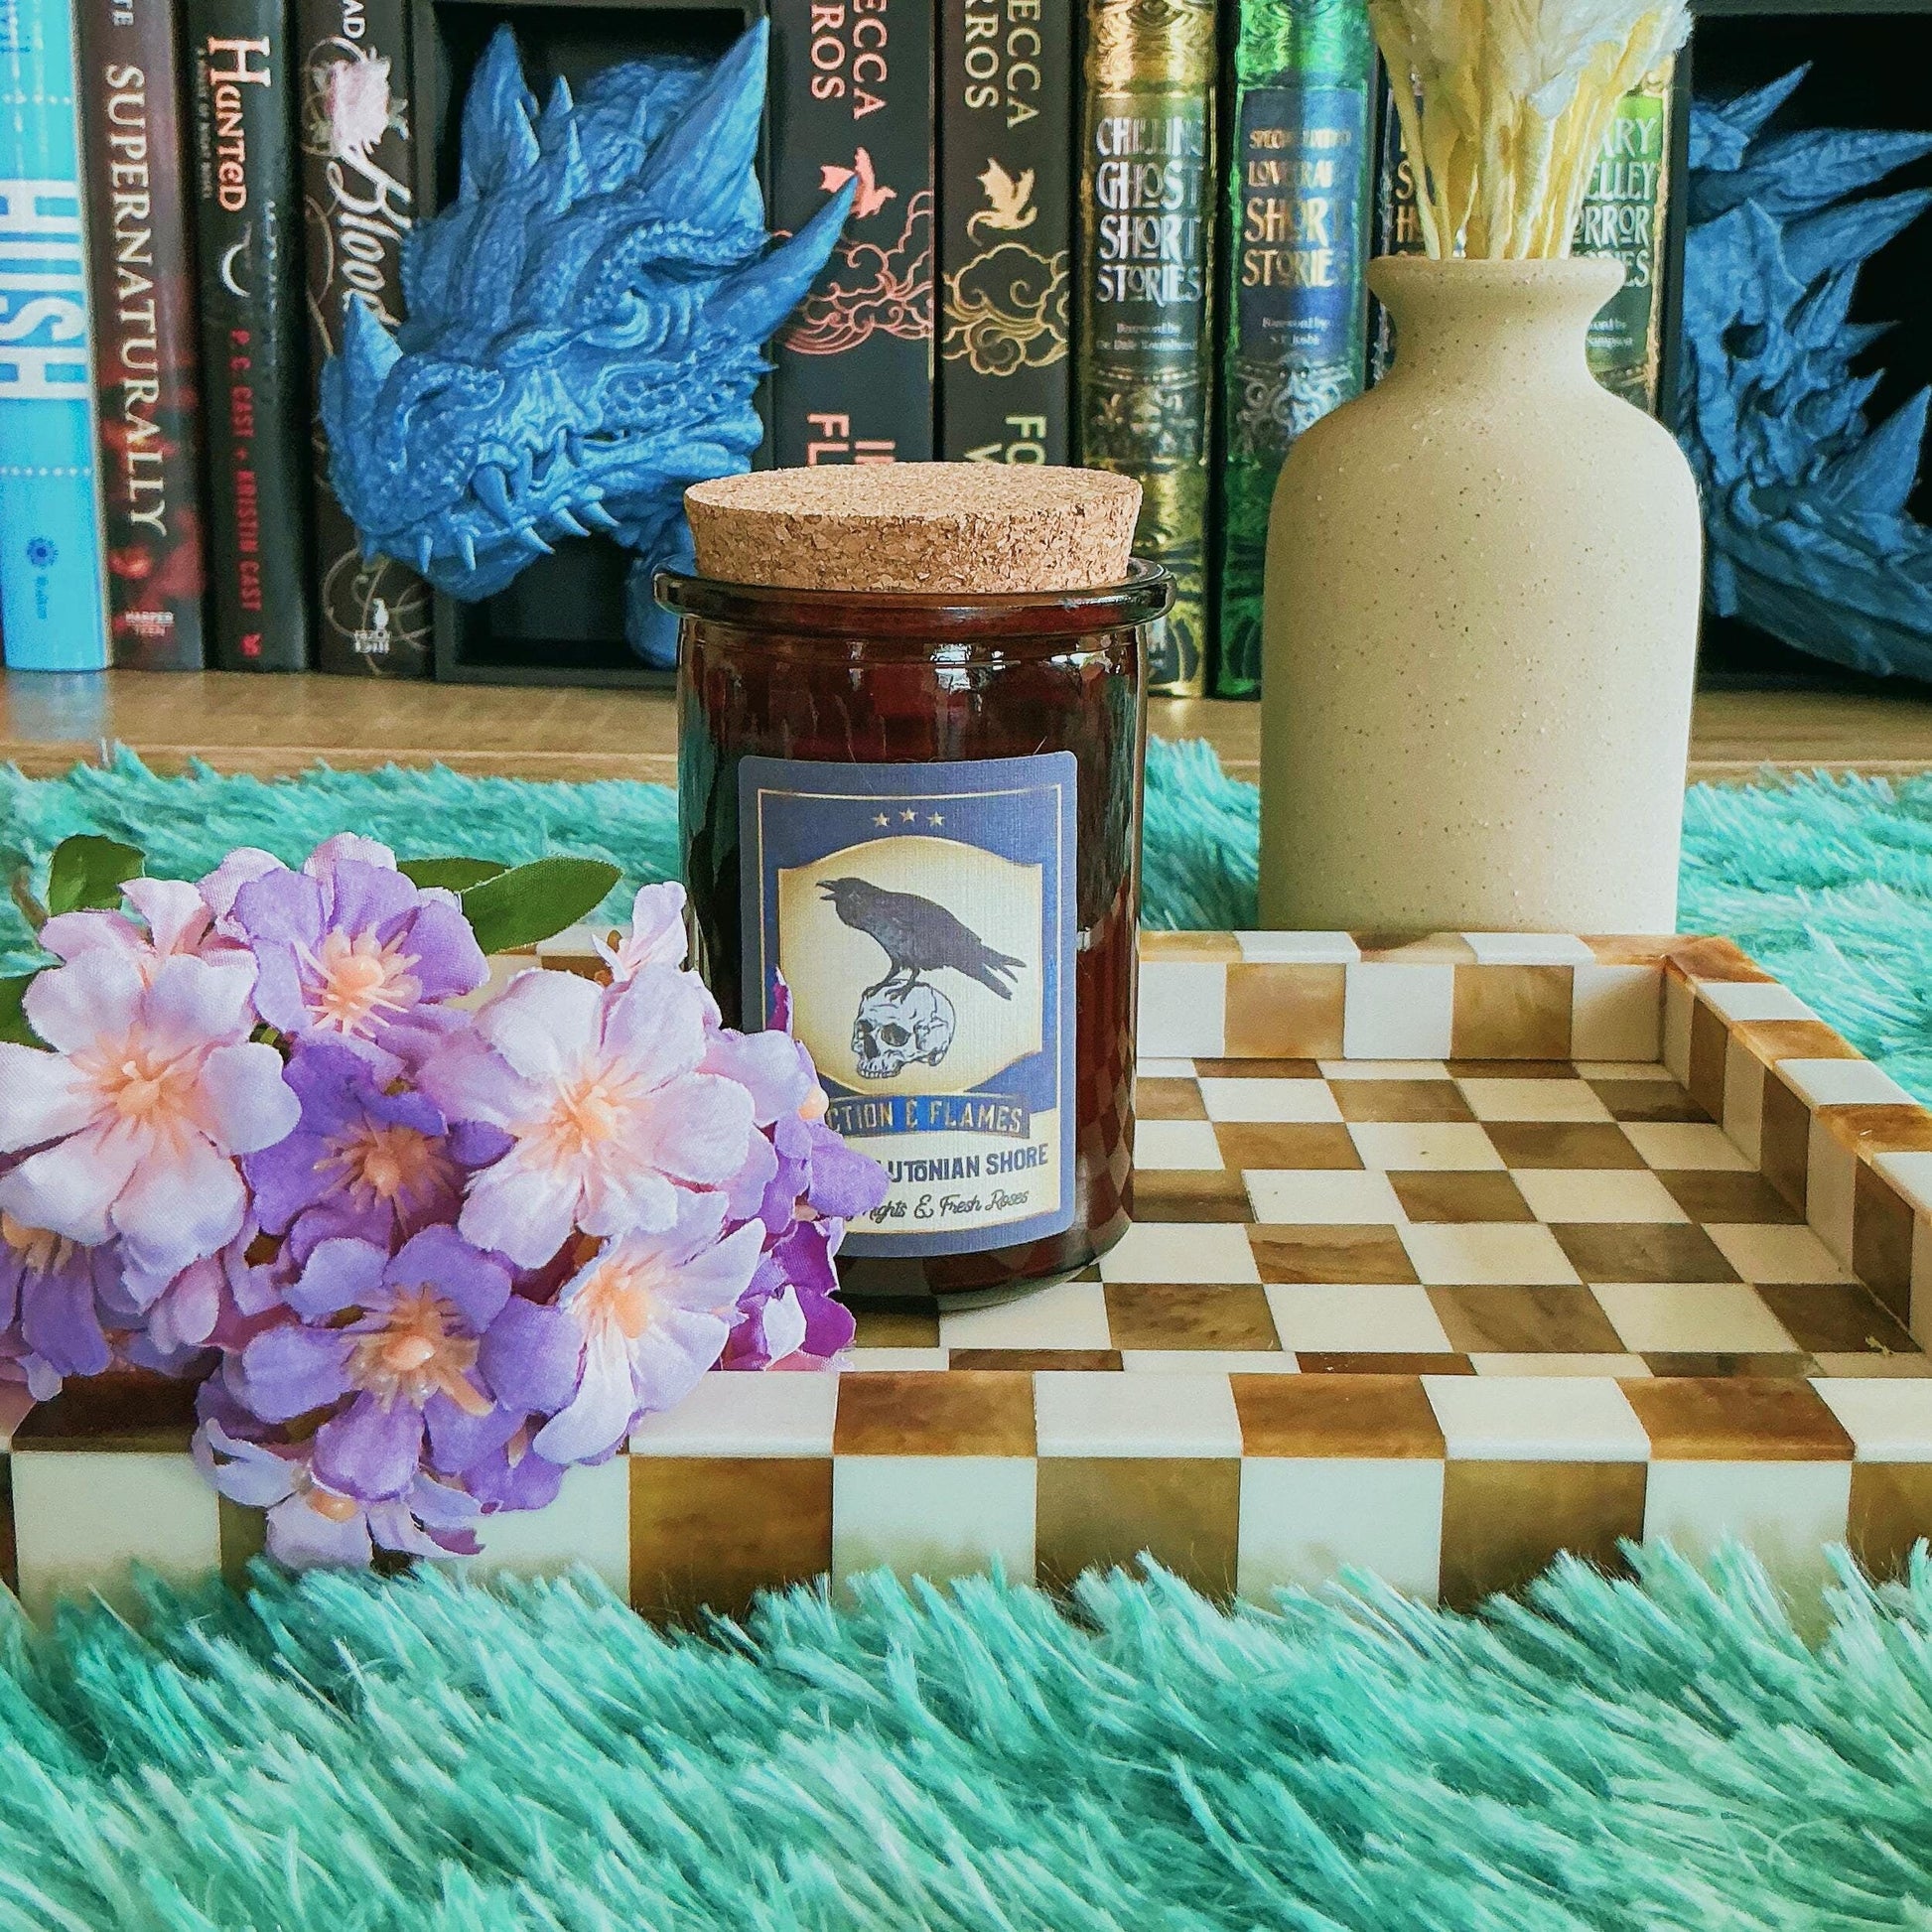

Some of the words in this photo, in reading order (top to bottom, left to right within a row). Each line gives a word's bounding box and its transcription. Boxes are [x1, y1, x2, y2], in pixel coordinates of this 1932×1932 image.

[810, 3, 846, 100] ROS
[964, 0, 1000, 109] ROS
[1096, 160, 1204, 210] GHOST
[1098, 213, 1202, 264] SHORT
[105, 64, 169, 539] SUPERNATURALLY
[1096, 264, 1203, 307] STORIES
[929, 1100, 1023, 1134] FLAMES
[883, 1155, 981, 1183] UTONIAN
[986, 1143, 1049, 1175] SHORE
[913, 1193, 935, 1220] &
[940, 1191, 983, 1217] Fresh
[984, 1188, 1031, 1211] Roses
